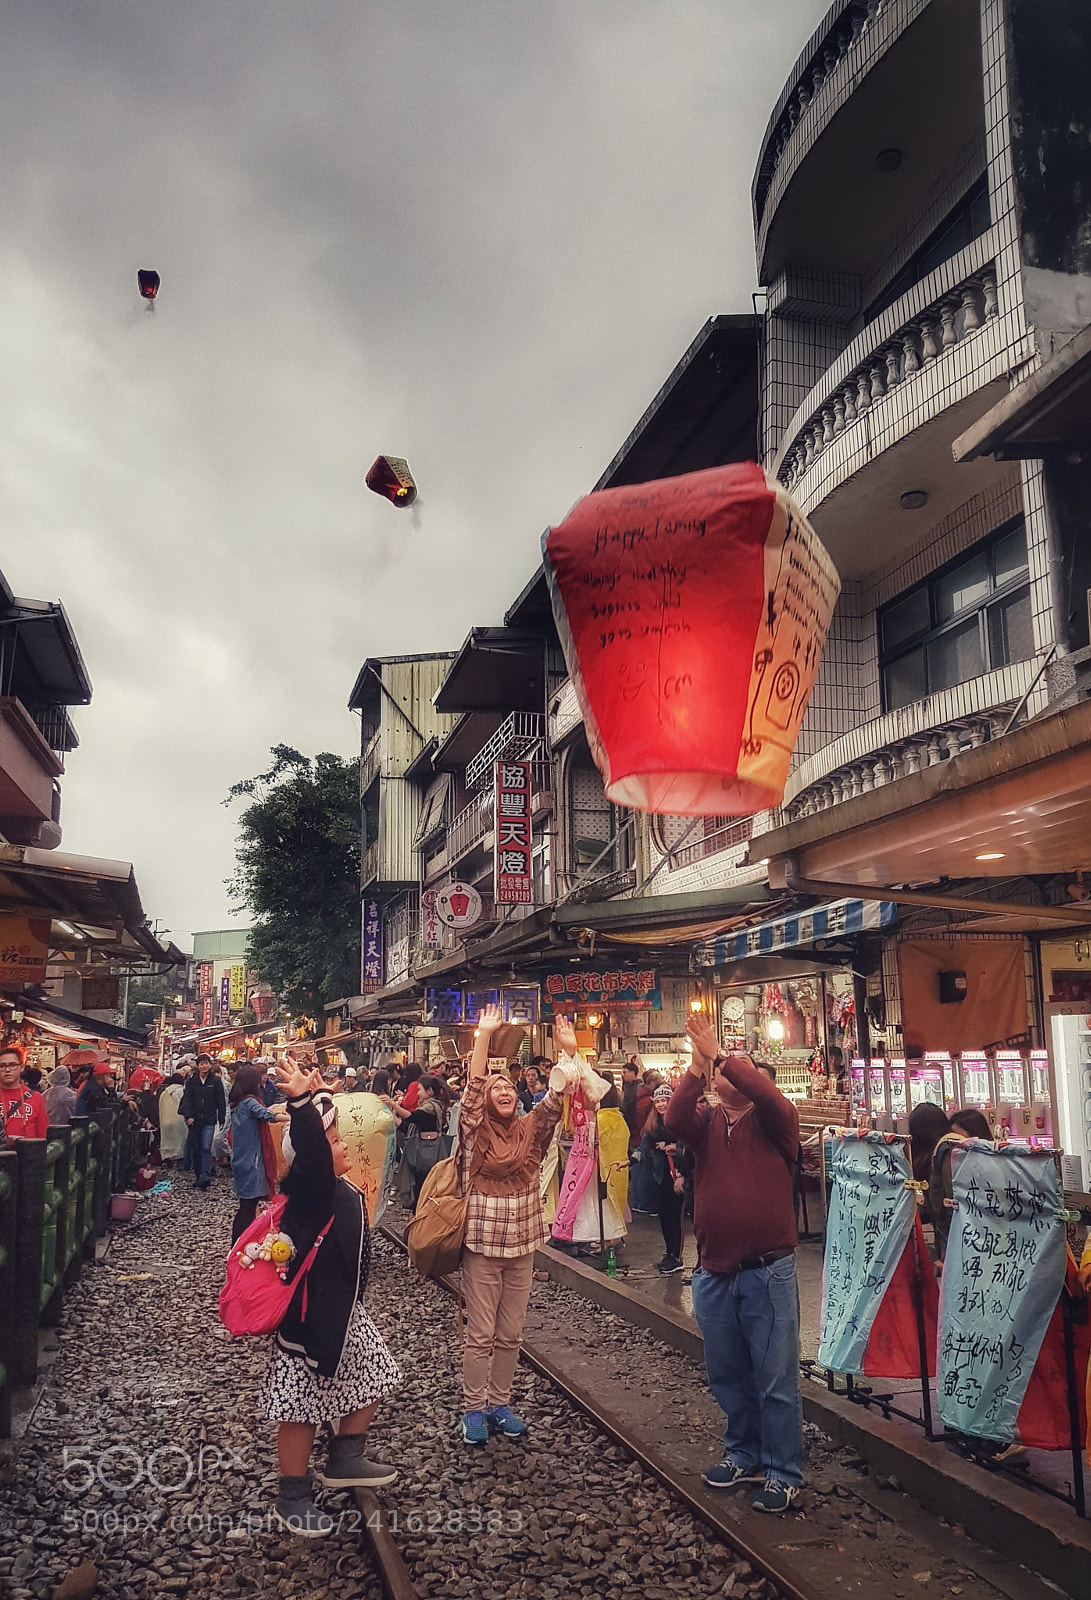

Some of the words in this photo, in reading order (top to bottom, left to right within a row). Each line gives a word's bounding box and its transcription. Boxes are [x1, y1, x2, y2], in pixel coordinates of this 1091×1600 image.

[499, 764, 527, 876] 協豐天燈
[365, 901, 381, 977] 吉祥天燈
[546, 970, 656, 994] 曾家花布天燈
